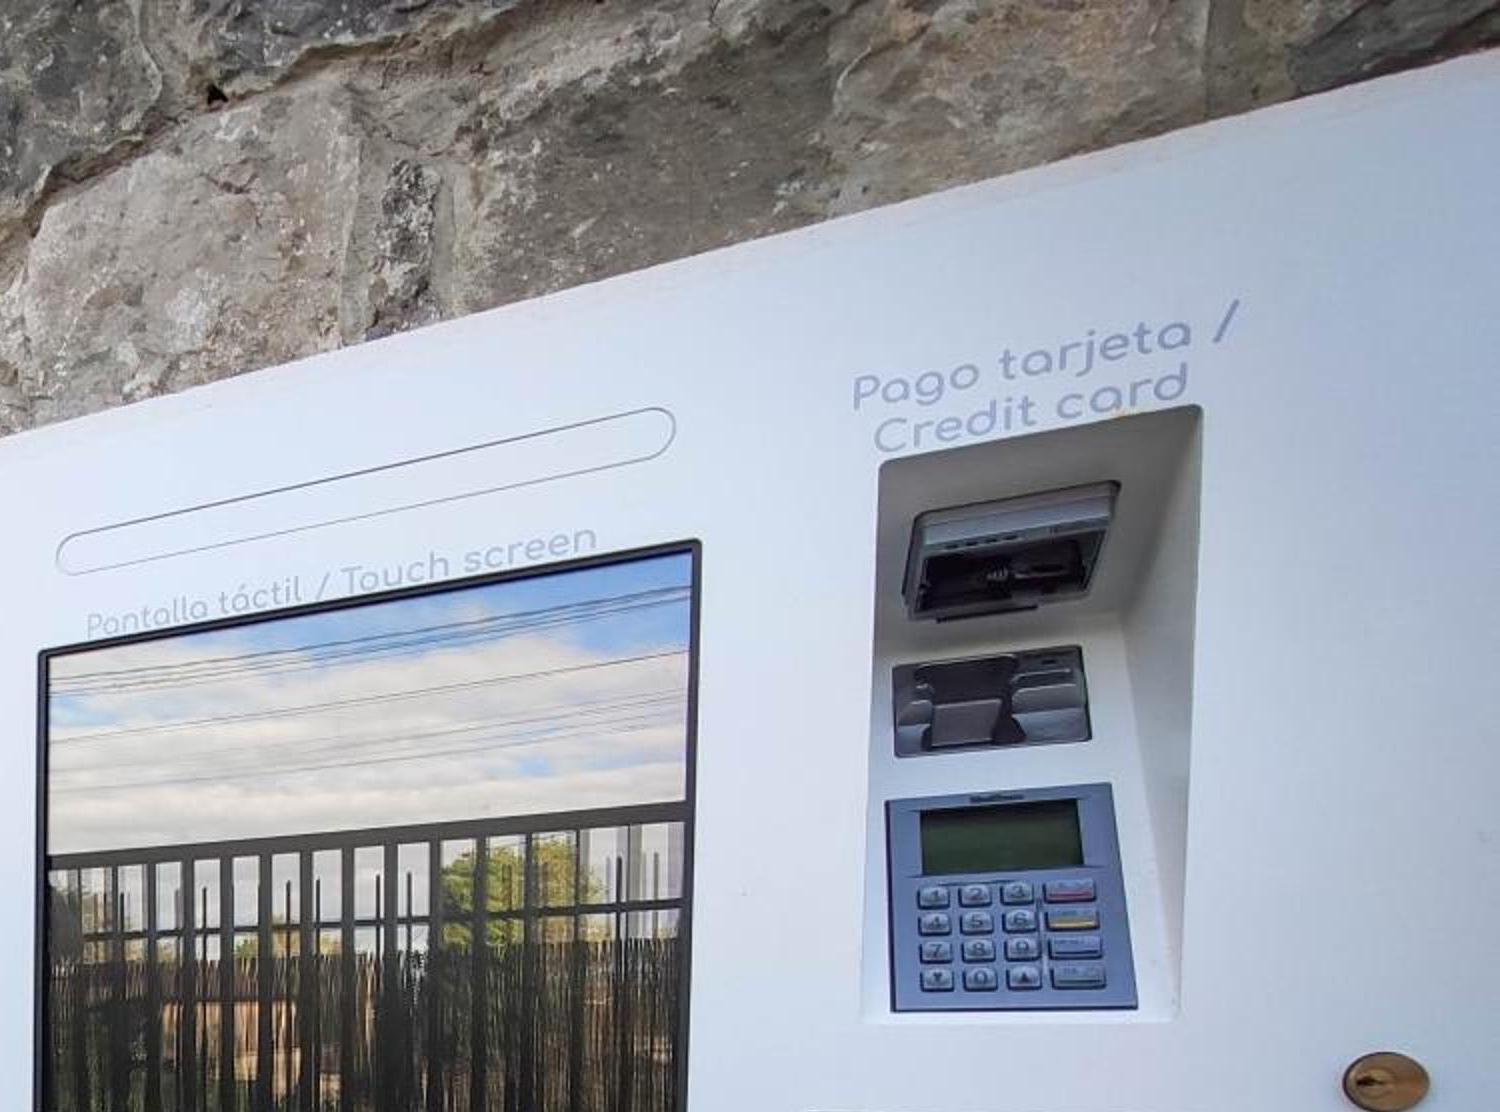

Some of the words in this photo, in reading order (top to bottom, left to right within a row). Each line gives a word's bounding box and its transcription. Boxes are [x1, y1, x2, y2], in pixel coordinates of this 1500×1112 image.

[853, 361, 980, 410] Pago
[999, 320, 1192, 380] tarjeta
[1213, 299, 1241, 344] /
[874, 396, 1040, 453] Credit
[1056, 362, 1189, 420] card
[87, 598, 209, 641] Pantalla
[219, 576, 302, 617] táctil
[315, 571, 332, 601] /
[341, 552, 450, 596] Touch
[464, 529, 598, 573] screen
